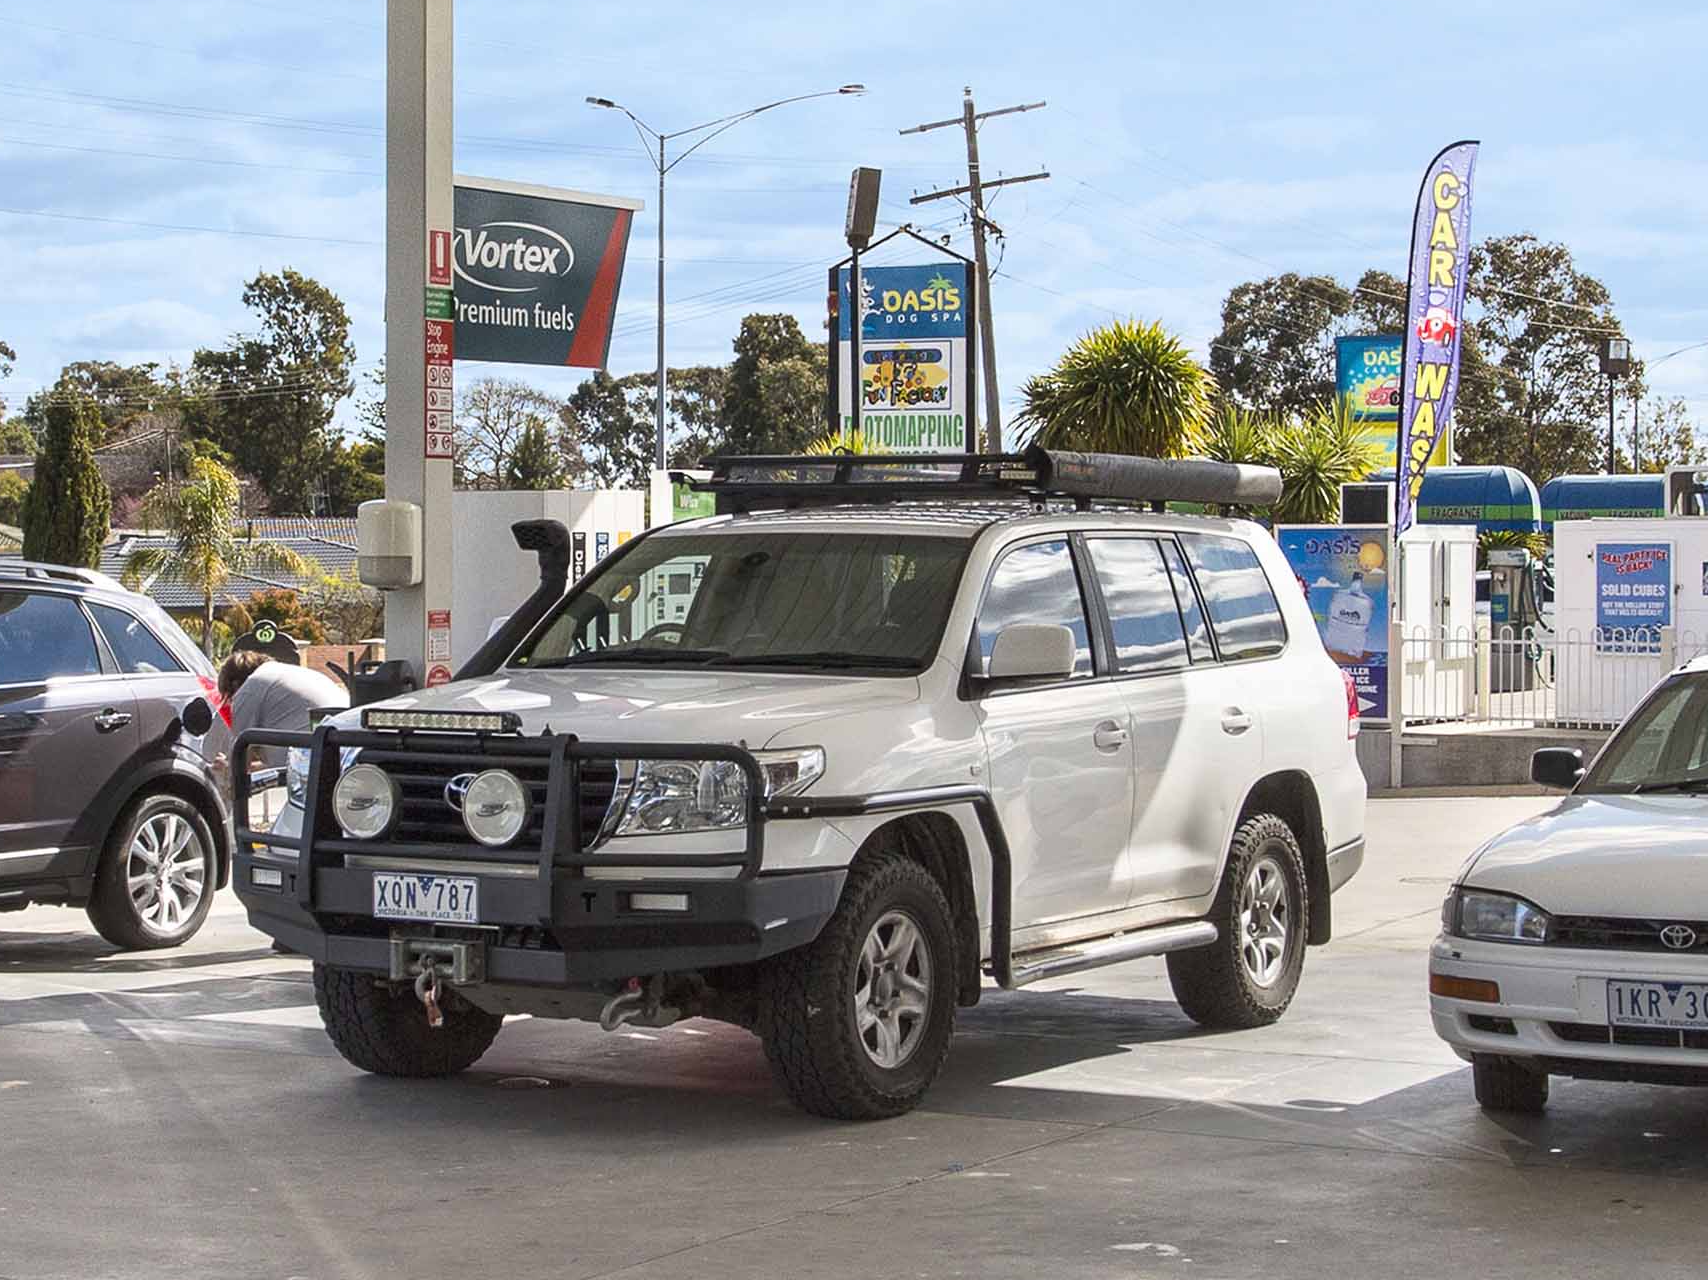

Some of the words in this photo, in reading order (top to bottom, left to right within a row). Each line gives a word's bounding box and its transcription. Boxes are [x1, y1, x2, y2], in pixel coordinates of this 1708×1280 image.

[1429, 171, 1460, 288] CAR
[455, 228, 560, 274] Vortex
[882, 286, 961, 313] OASIS
[533, 302, 575, 331] fuels
[885, 313, 918, 324] DOG
[931, 312, 962, 323] SPA
[427, 321, 443, 343] Stop
[1305, 534, 1361, 555] OASIS
[1601, 583, 1631, 597] SOLID
[1632, 583, 1666, 597] CUBES
[378, 880, 417, 909] XQN
[434, 883, 474, 912] 787
[1615, 987, 1662, 1018] 1KR
